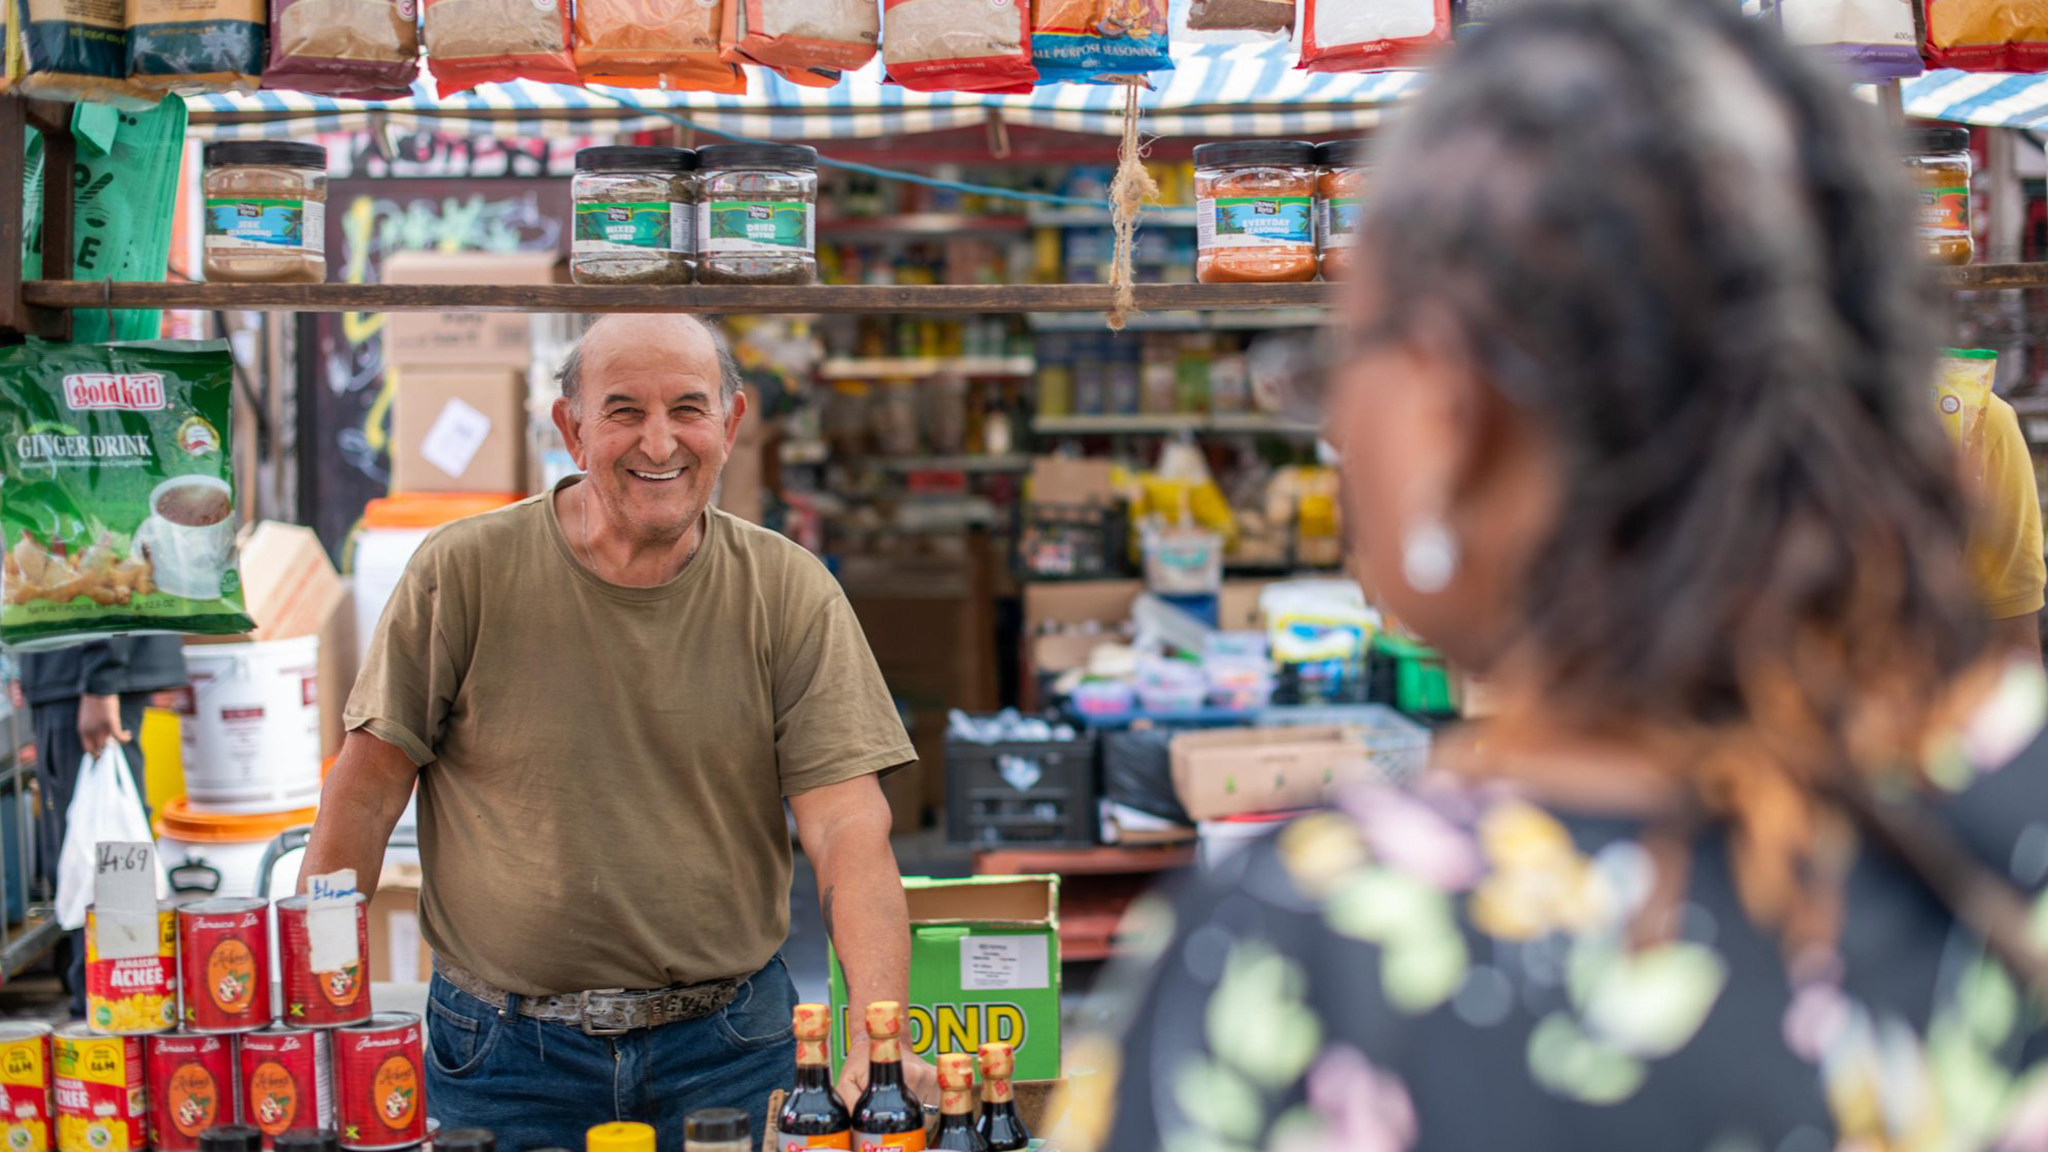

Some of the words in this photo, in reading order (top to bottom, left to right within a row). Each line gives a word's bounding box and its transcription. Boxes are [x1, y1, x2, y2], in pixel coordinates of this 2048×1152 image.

[1053, 43, 1101, 59] PURPOSE
[1102, 44, 1162, 58] SEASONING
[746, 223, 776, 232] DRIED
[1242, 219, 1291, 228] EVERYDAY
[605, 225, 637, 234] MIXED
[1244, 226, 1290, 235] SEASONING
[608, 233, 634, 241] HERBS
[16, 434, 91, 459] GINGER
[92, 434, 153, 457] DRINK
[110, 967, 164, 987] ACKEE
[841, 1002, 1027, 1058] OND
